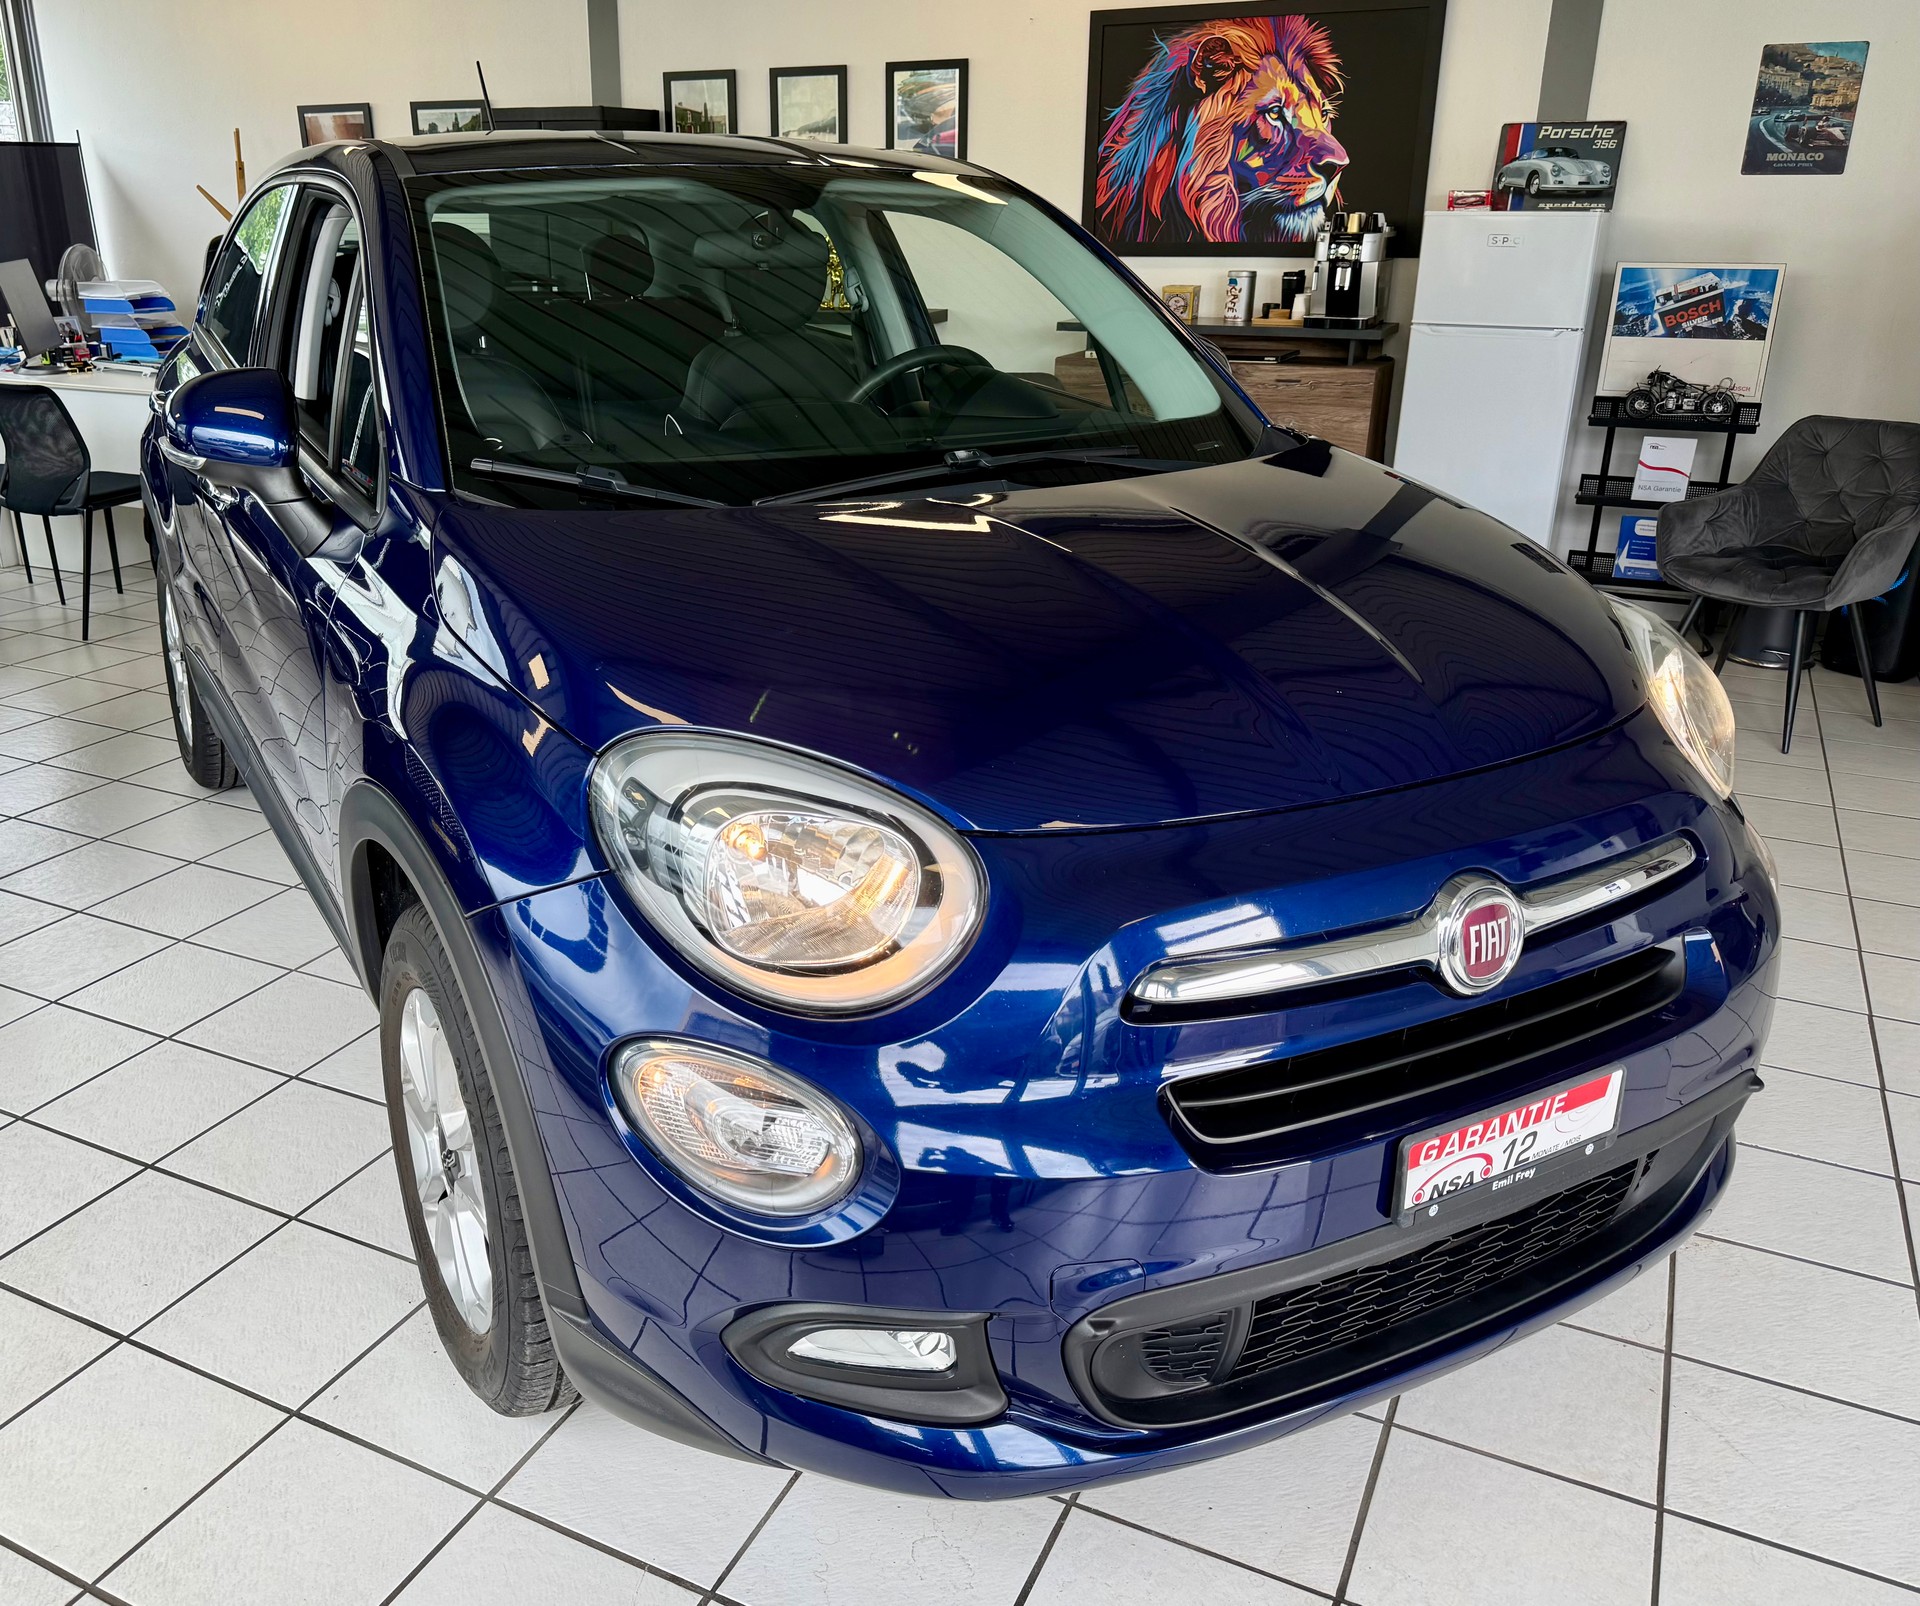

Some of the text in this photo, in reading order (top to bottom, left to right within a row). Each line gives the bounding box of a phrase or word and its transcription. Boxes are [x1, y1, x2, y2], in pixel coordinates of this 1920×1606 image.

[1538, 125, 1614, 139] Porsche
[1592, 139, 1617, 149] 356
[1765, 152, 1824, 161] MONACO
[1538, 200, 1606, 209] speedster
[1664, 299, 1721, 328] BOSCH
[1681, 315, 1708, 328] SILVER
[1652, 485, 1682, 493] Garantie
[1469, 916, 1508, 966] FIAT
[1418, 1092, 1568, 1166] GARANTIE
[1502, 1130, 1538, 1171] 12
[1532, 1143, 1560, 1159] MONATE
[1564, 1134, 1581, 1147] MOIS
[1428, 1170, 1476, 1202] NSA
[1491, 1167, 1537, 1191] Emil Frey
